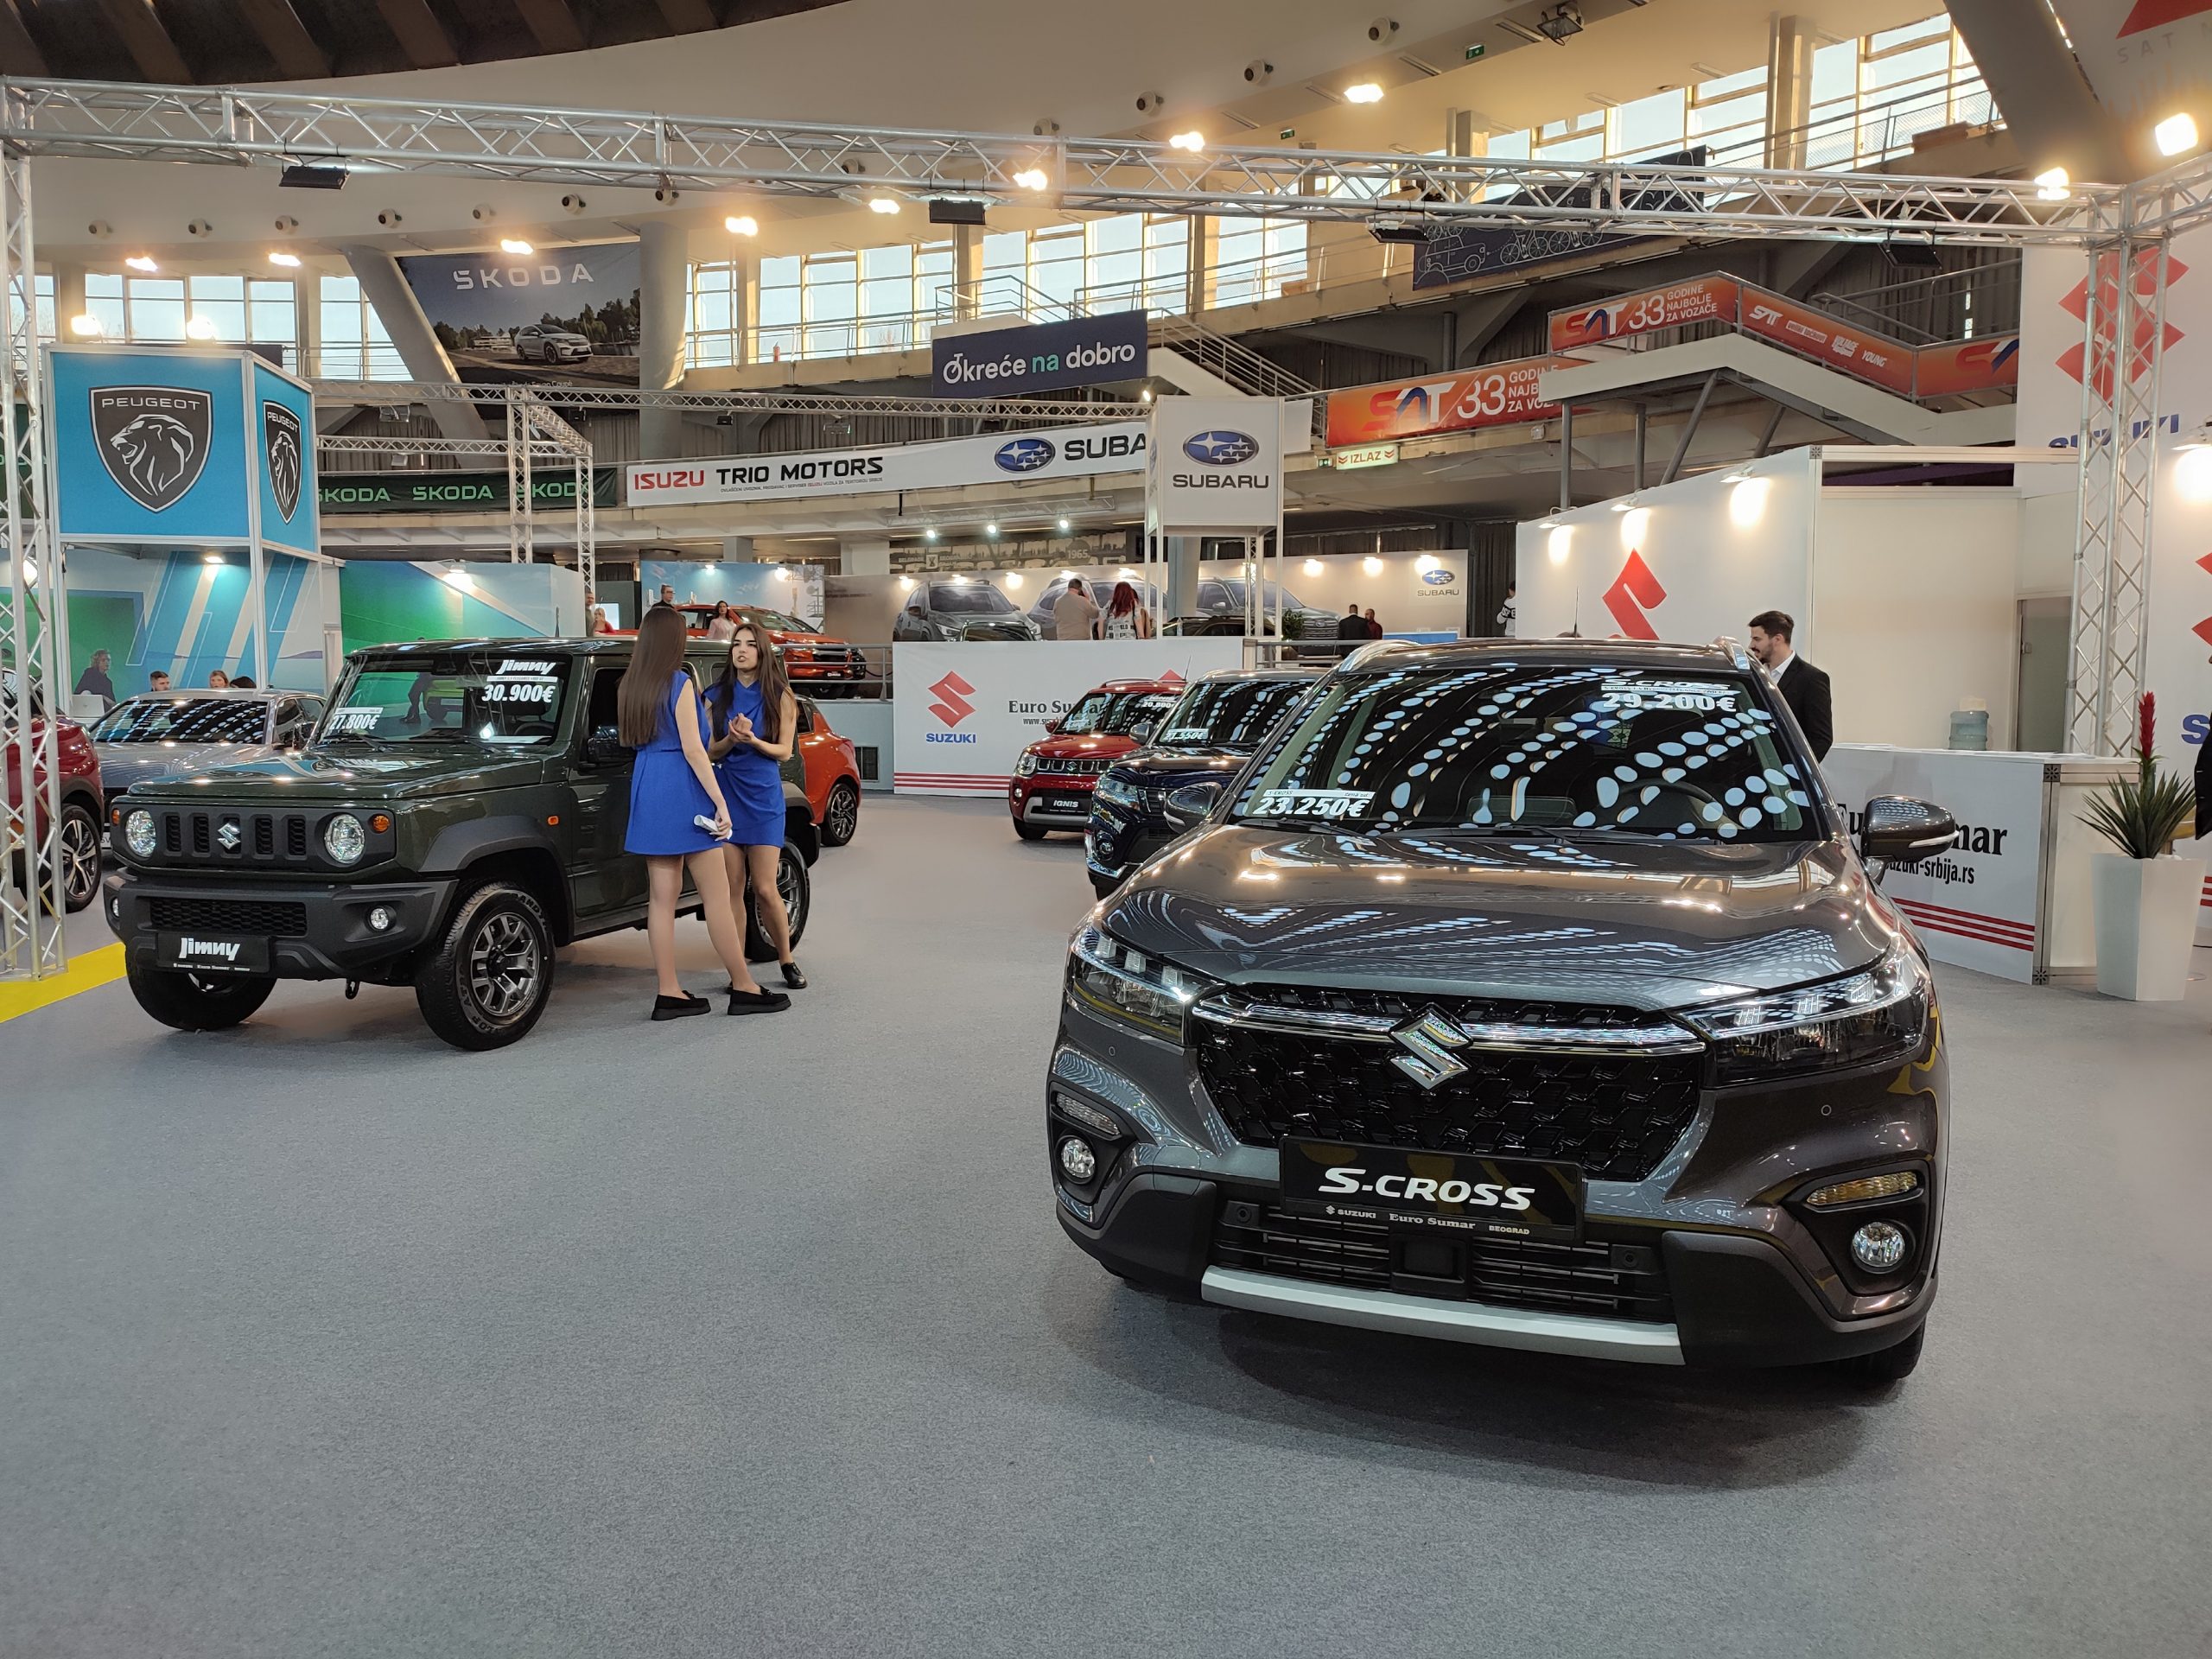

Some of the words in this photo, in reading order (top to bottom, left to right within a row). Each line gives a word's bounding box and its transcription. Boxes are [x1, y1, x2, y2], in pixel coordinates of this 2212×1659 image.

[1667, 284, 1705, 301] GODINE
[1667, 293, 1712, 312] NAJBOLJE
[1630, 295, 1666, 330] 33
[1666, 312, 1678, 323] ZA
[1680, 302, 1718, 320] VOZAČE
[1032, 353, 1059, 373] na
[1065, 342, 1136, 368] dobro
[1862, 349, 1888, 368] YOUNG
[1509, 365, 1559, 384] GODI
[102, 397, 201, 410] PEUGEOT
[1458, 375, 1506, 419] 33
[1507, 400, 1523, 413] ZA
[266, 411, 300, 433] PEUGEOT
[1350, 451, 1382, 464] IZLAZ
[634, 469, 705, 490] ISUZU
[716, 466, 770, 485] TRIO
[780, 456, 884, 481] MOTORS
[1173, 474, 1269, 489] SUBARU
[495, 659, 557, 676] Jimny
[481, 683, 556, 703] 30.900€
[1601, 692, 1737, 713] 29.200€
[1008, 700, 1047, 714] Euro
[329, 714, 380, 731] 27.800€
[925, 733, 976, 744] SUZUKI
[1052, 799, 1079, 808] IGNIS
[1253, 797, 1370, 817] 23.250€
[1885, 856, 1975, 885] uzuki-srbija.rs
[178, 937, 241, 962] Jimny
[1318, 1167, 1536, 1211] S-CROSS
[1337, 1209, 1376, 1219] SUZUKI
[1389, 1213, 1424, 1224] Euro
[1427, 1217, 1476, 1230] Sumar
[1489, 1224, 1530, 1235] BEOGRAD
